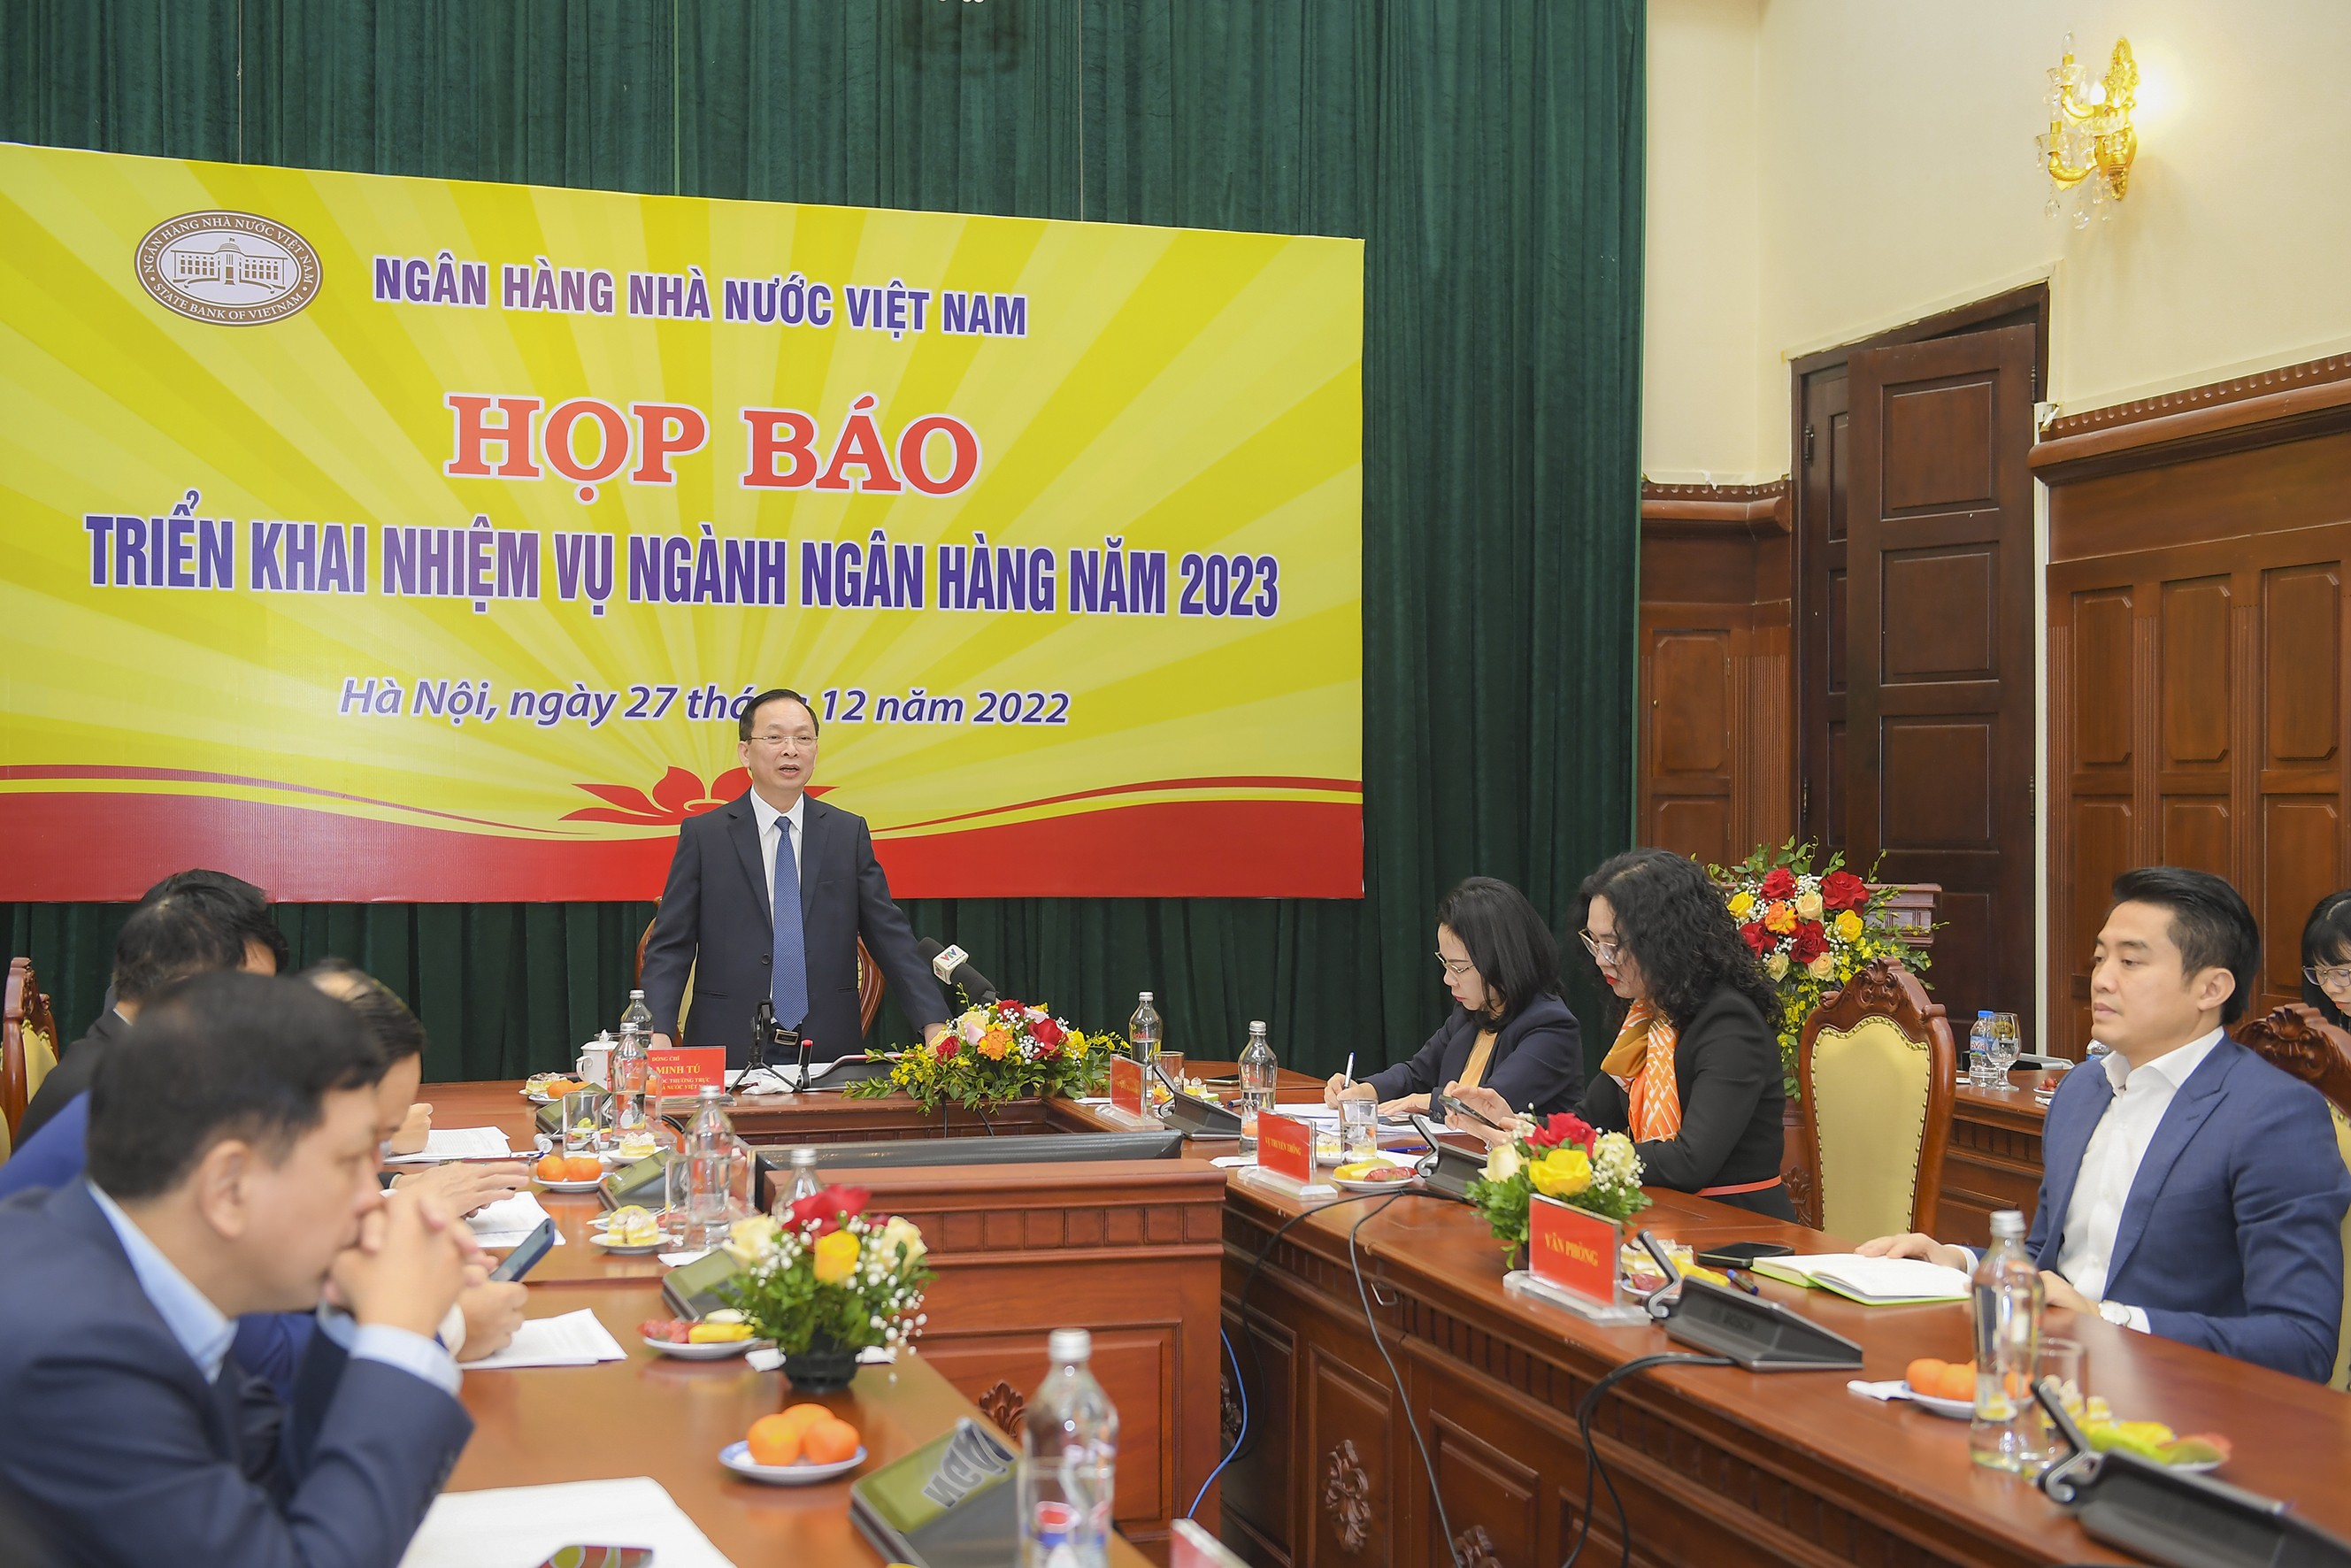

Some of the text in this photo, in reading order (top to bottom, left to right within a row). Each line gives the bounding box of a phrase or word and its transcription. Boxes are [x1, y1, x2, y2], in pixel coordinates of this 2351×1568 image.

[142, 215, 314, 285] NGÂN HÀNG NHÀ NƯỚC VIỆT NAM
[152, 282, 304, 320] STATE BANK OF VIETNAM
[376, 251, 1025, 338] NGÂN HÀNG NHÀ NƯỚC VIỆT NAM
[449, 396, 977, 501] HỌP BÁO
[87, 490, 1277, 617] TRIỂN KHAI NHIỆM VỤ NGÀNH NGÂN HÀNG NĂM 2023
[342, 680, 1068, 726] Hà Nội, ngày 27 thá 12 năm 2022
[656, 1063, 701, 1074] MINH TÚ
[1544, 1231, 1564, 1254] VĂN
